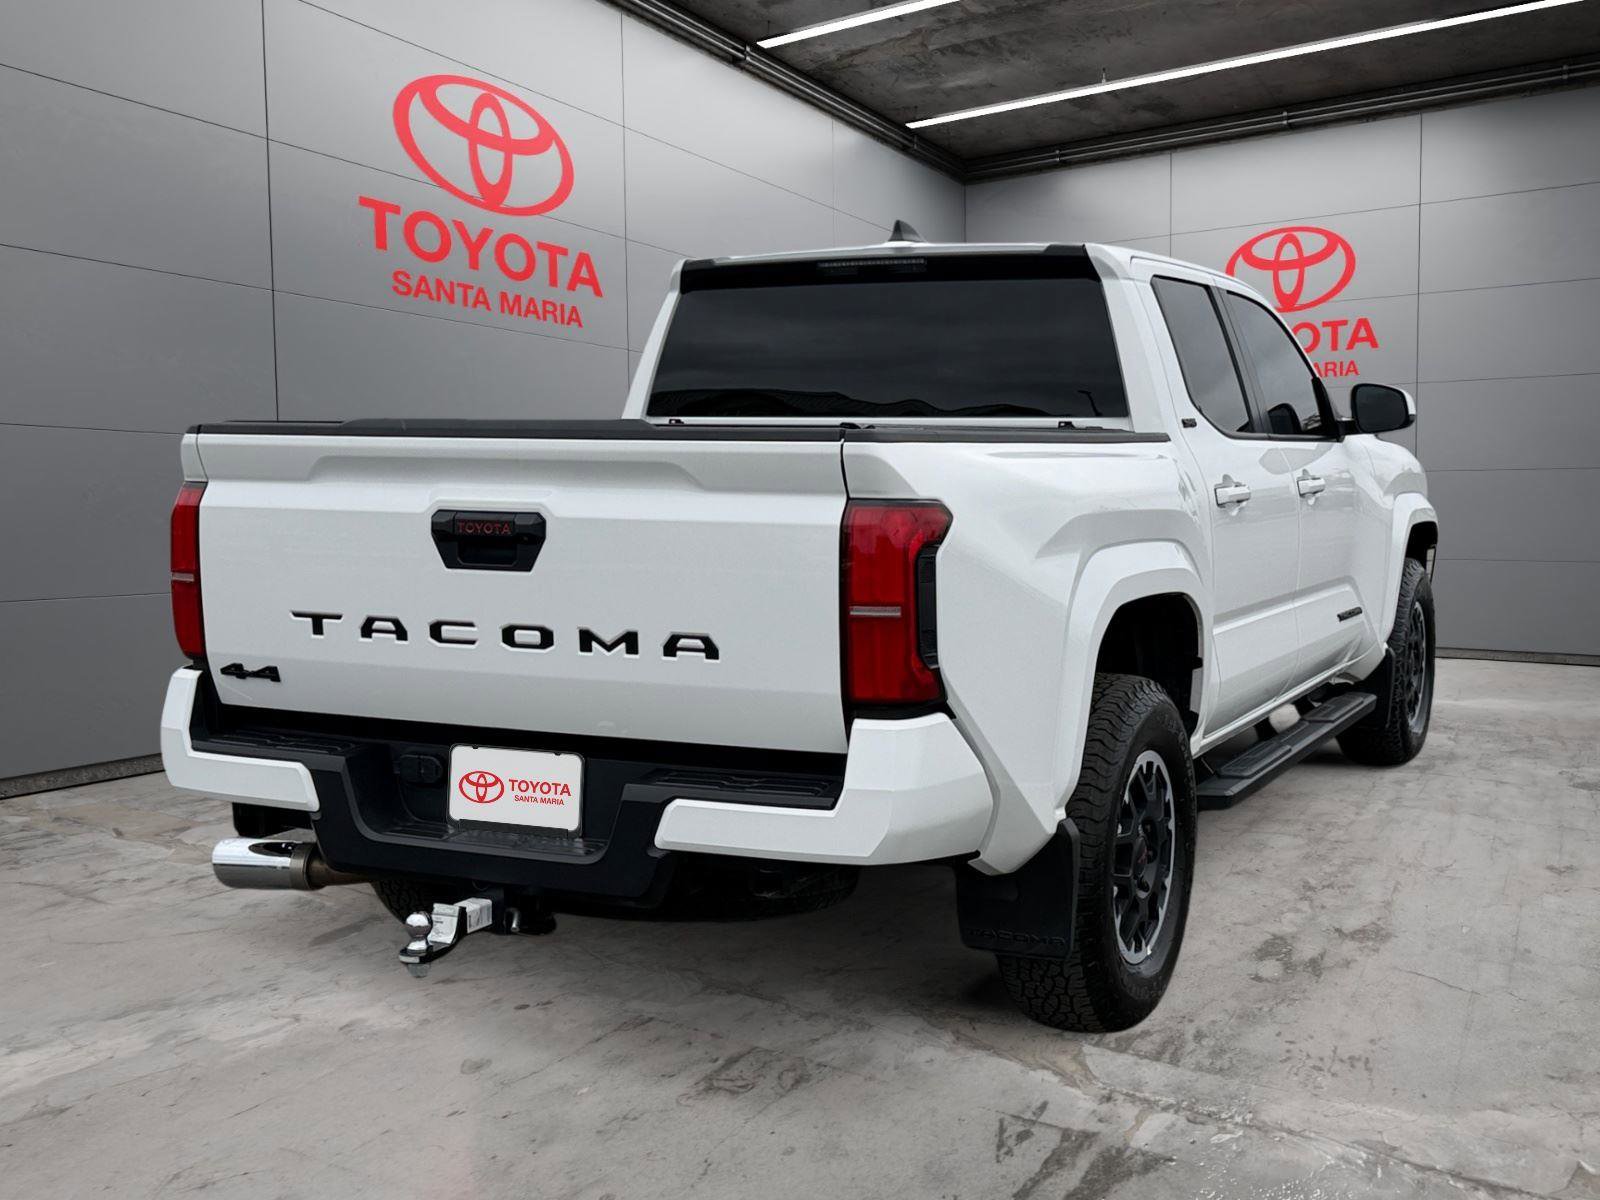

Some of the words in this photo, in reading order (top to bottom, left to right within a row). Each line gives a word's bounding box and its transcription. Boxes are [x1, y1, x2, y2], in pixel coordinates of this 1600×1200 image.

[358, 195, 604, 298] TOYOTA
[391, 269, 491, 312] SANTA
[499, 291, 584, 329] MARIA
[456, 520, 512, 535] TOYOTA
[291, 610, 721, 662] TACOMA
[508, 778, 571, 796] TOYOTA
[514, 794, 539, 804] SANTA
[539, 797, 565, 806] MARIA
